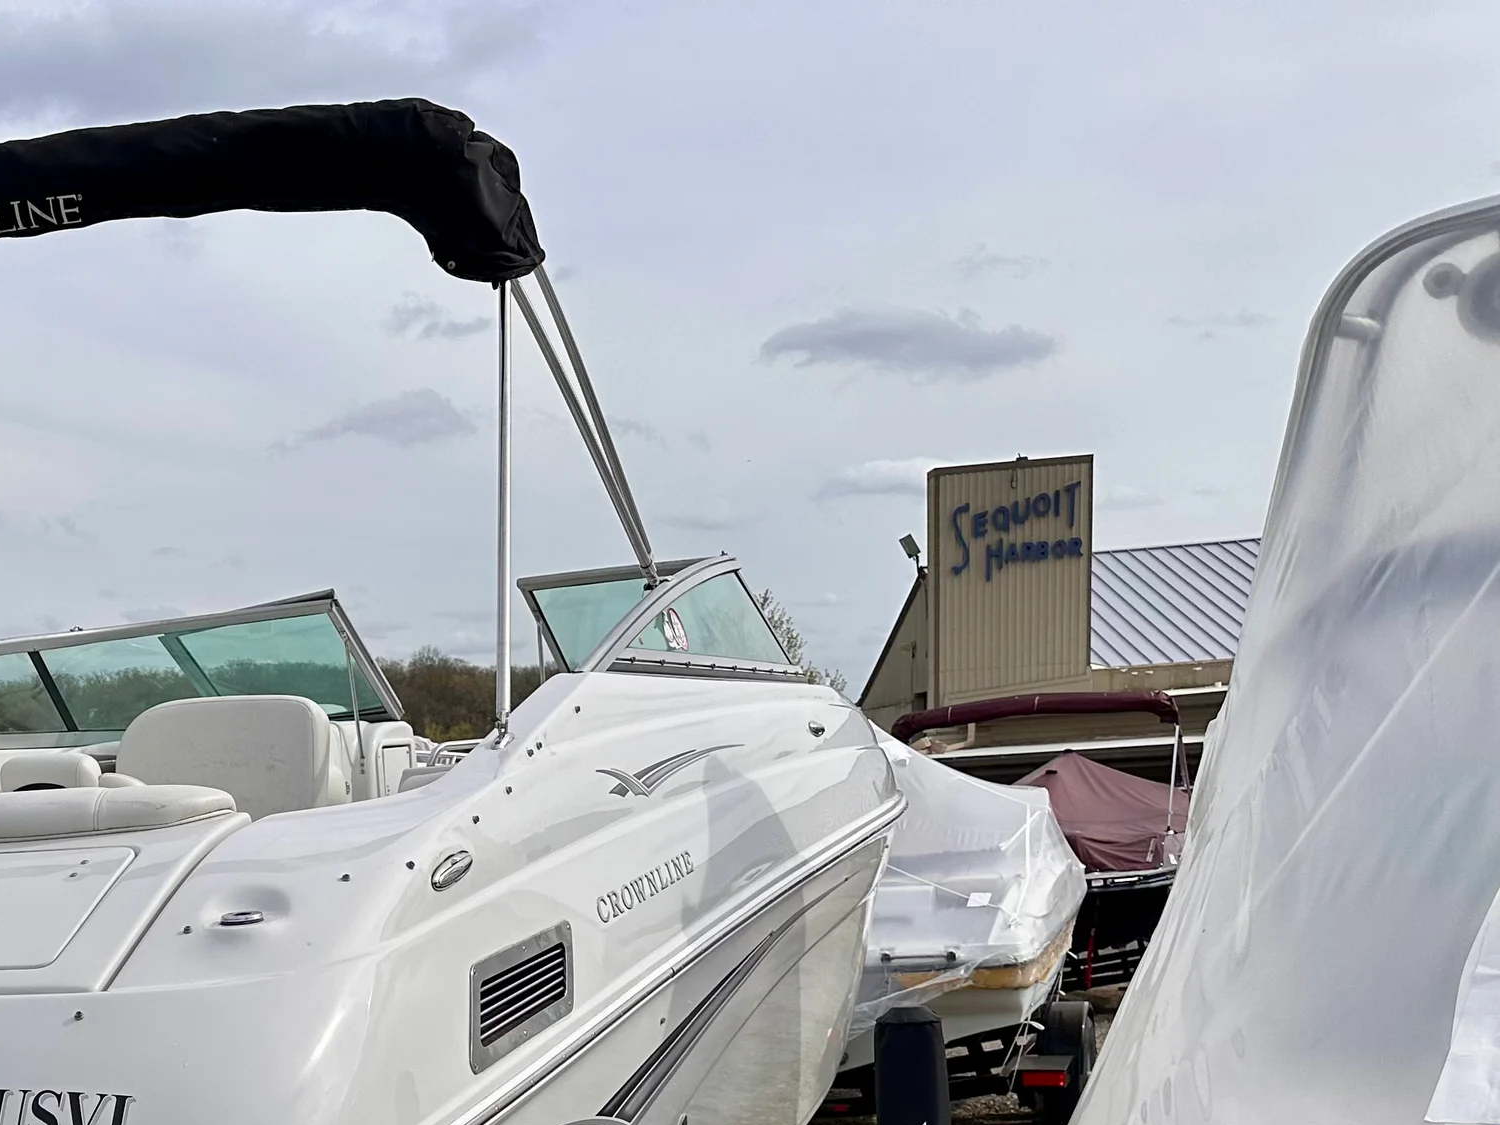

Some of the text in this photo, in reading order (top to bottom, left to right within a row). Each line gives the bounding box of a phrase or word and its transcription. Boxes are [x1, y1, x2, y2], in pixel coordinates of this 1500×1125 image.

[951, 480, 1082, 576] SEQUOIT
[985, 537, 1084, 582] HARBOR
[596, 850, 695, 923] CROWNLINE
